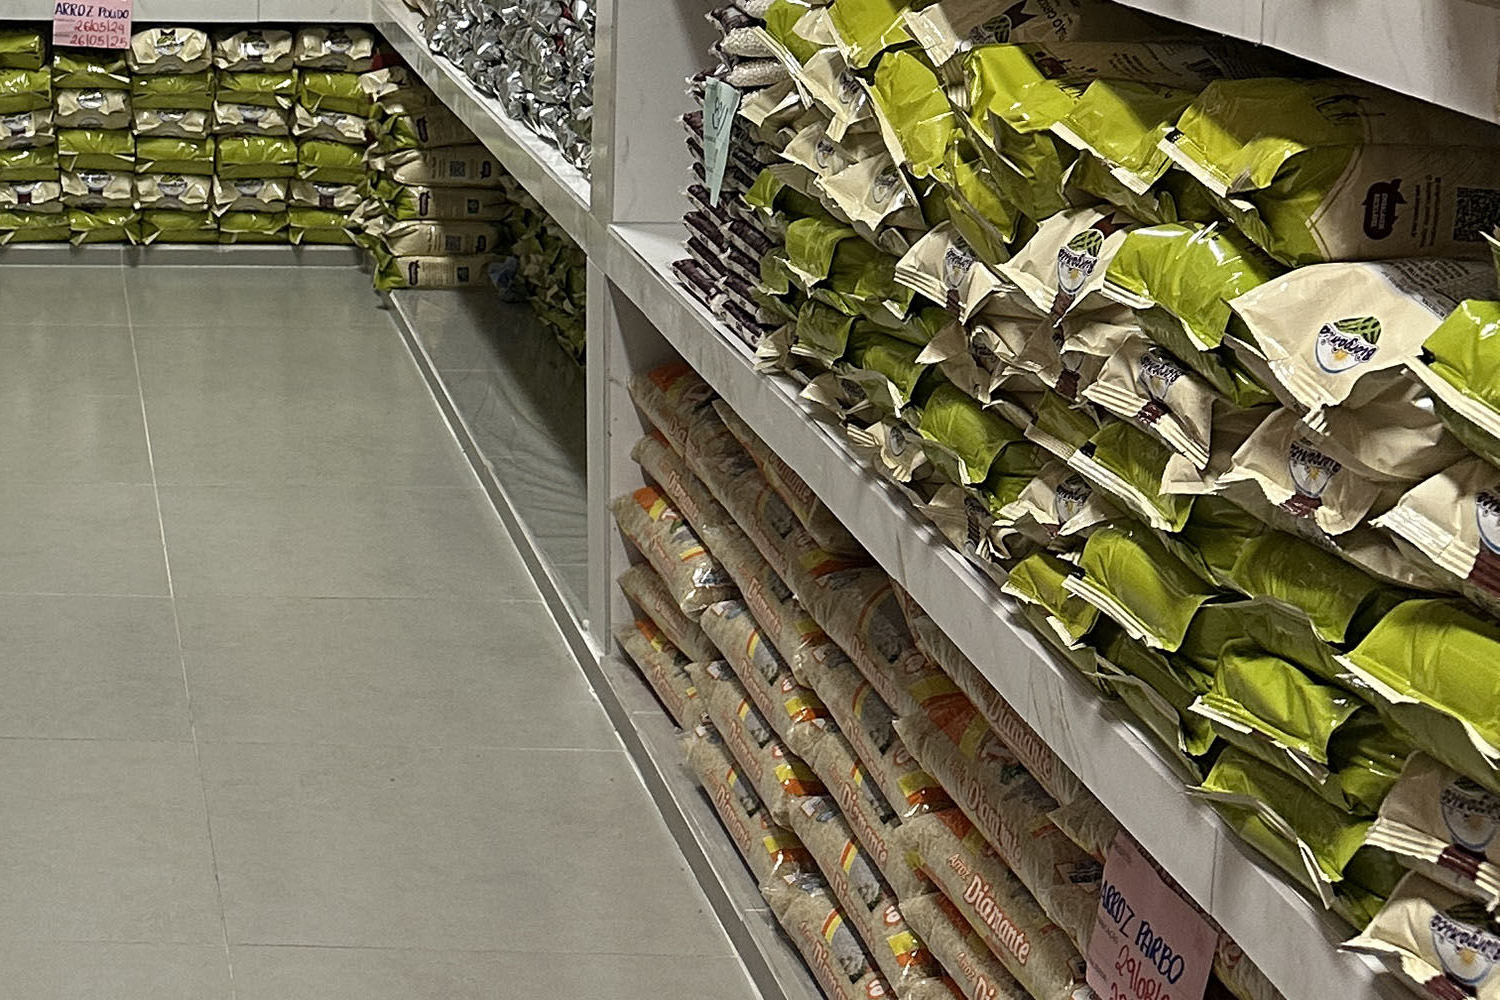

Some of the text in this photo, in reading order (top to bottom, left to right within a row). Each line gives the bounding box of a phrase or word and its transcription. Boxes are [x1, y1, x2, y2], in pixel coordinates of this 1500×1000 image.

[55, 2, 94, 17] ARROZ
[1320, 322, 1380, 363] Biorgânica
[962, 872, 1031, 966] Diamante
[1100, 879, 1185, 985] ARROZ PARBO
